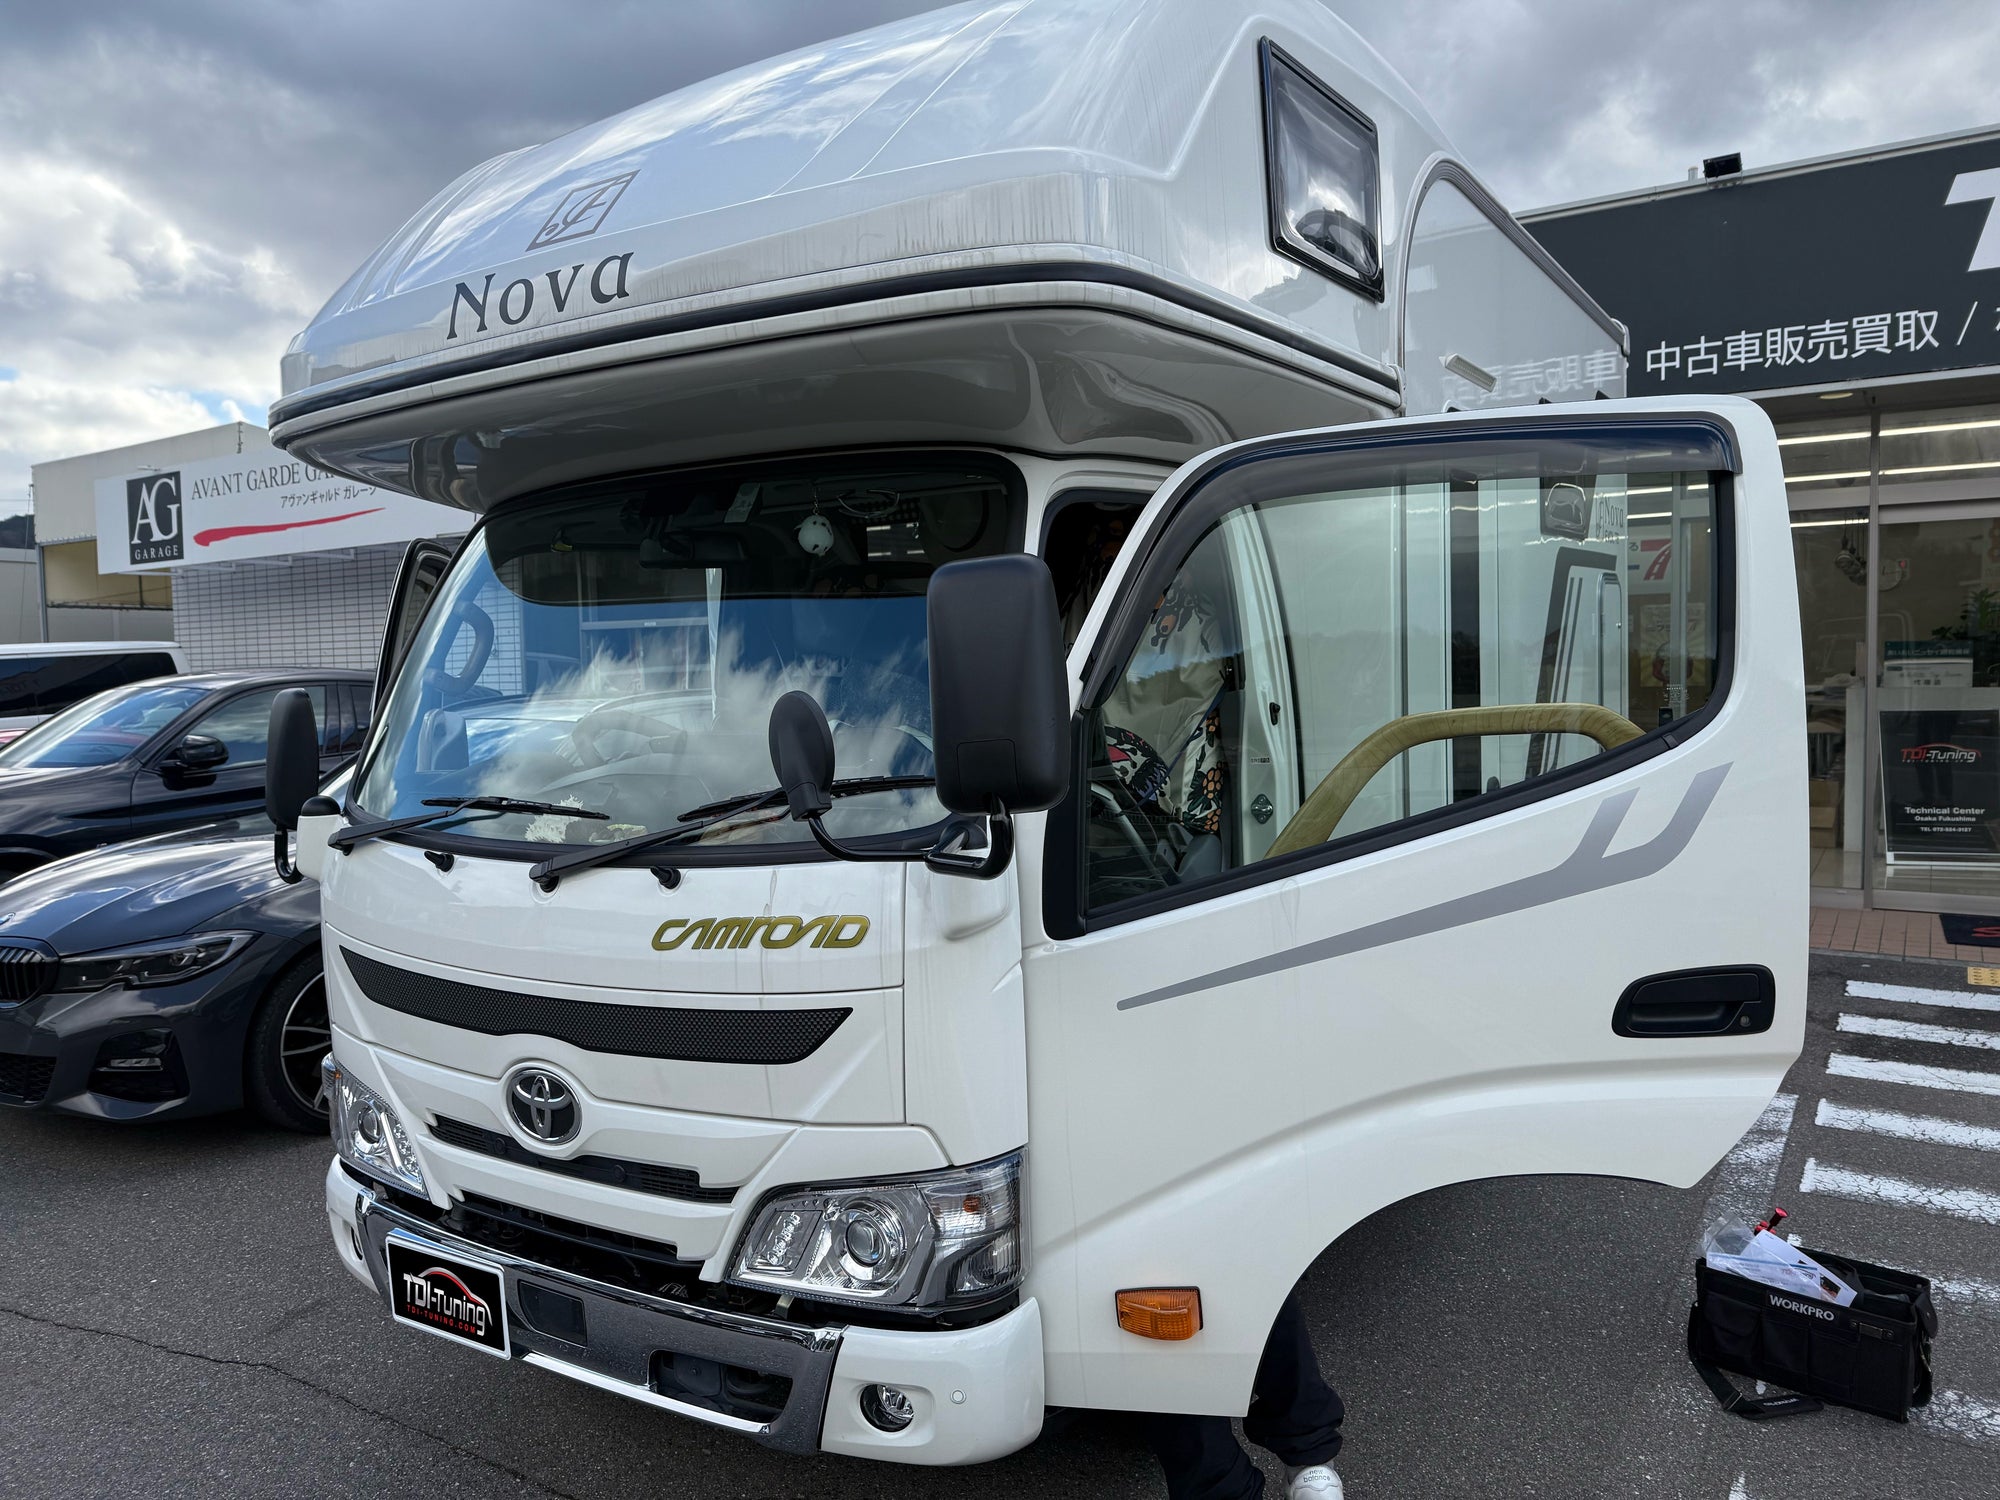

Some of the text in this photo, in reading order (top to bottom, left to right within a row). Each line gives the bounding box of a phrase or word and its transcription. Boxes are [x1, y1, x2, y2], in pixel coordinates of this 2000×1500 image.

[447, 252, 634, 340] Nova
[1646, 310, 1940, 381] 中古車販売買取
[191, 472, 243, 500] AVANT
[246, 463, 301, 491] GARDE
[131, 477, 180, 545] AG
[134, 545, 179, 560] GARAGE
[1901, 749, 1976, 763] TDI-Tuning
[1904, 807, 1985, 815] Technical Center
[403, 1273, 486, 1337] TDI-Tuning
[406, 1304, 476, 1334] TDI-TUNING.COM
[1769, 1294, 1835, 1321] WORKPRO
[1304, 1474, 1330, 1482] balance
